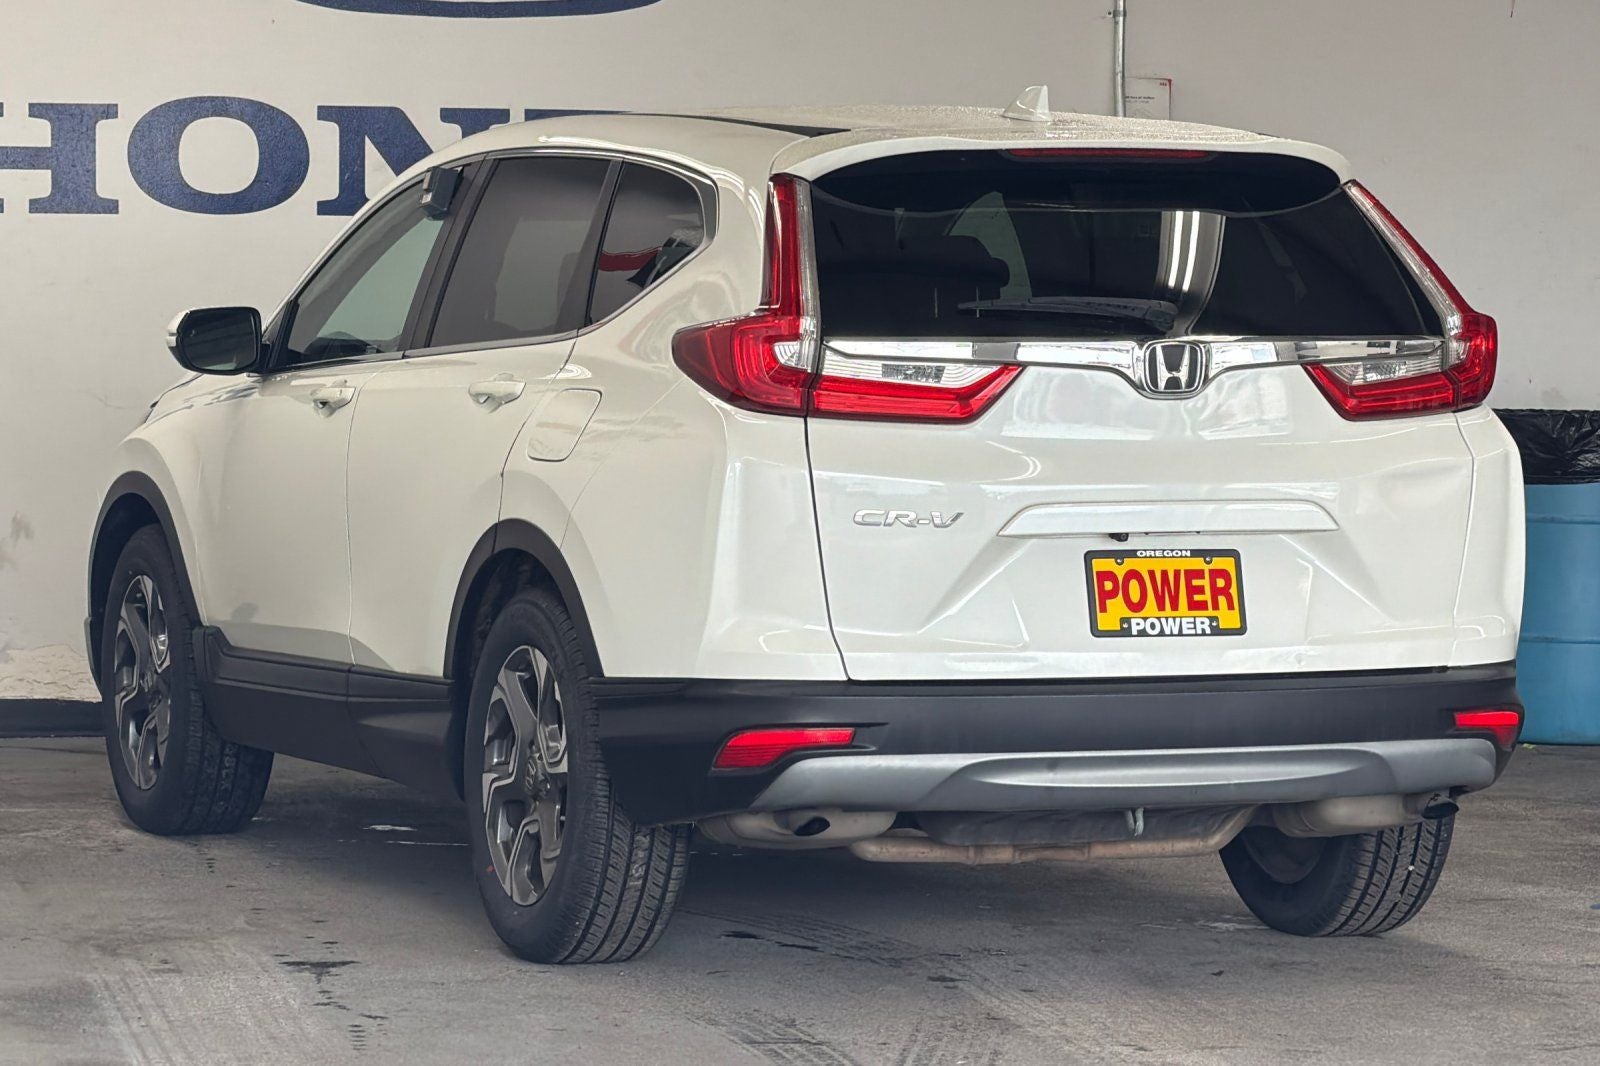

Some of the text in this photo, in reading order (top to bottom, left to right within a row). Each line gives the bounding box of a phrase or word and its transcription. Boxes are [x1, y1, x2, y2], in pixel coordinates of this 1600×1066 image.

[853, 509, 964, 529] CR-V
[1136, 550, 1191, 558] OREGON
[1095, 568, 1235, 614] POWER
[1130, 616, 1212, 636] POWER
